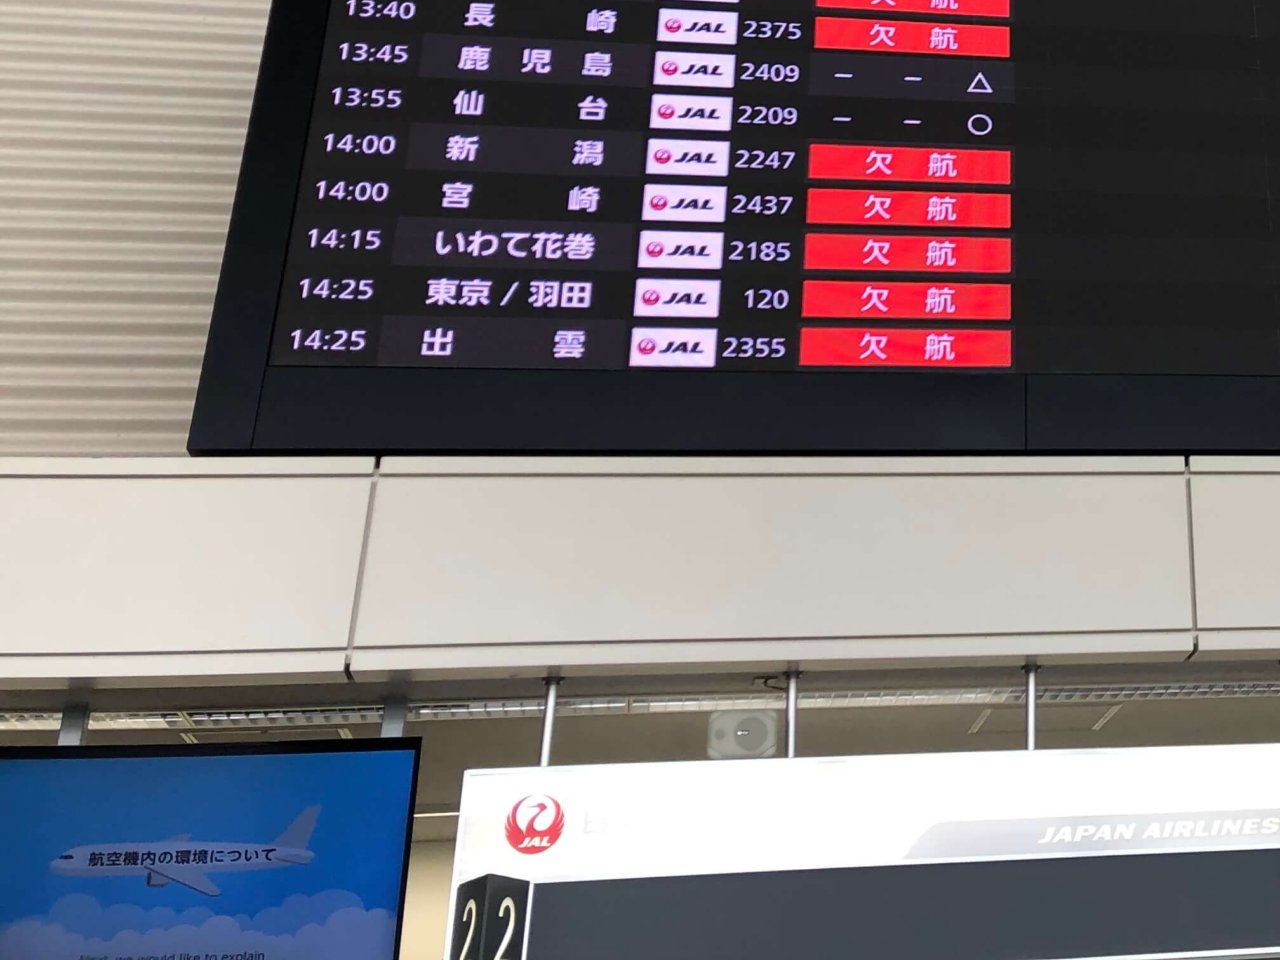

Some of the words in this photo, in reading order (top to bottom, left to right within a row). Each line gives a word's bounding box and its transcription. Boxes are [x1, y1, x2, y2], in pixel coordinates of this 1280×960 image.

[347, 0, 416, 19] 13:40
[684, 21, 727, 34] JAL
[743, 21, 801, 39] 2375
[340, 43, 408, 63] 13:45
[681, 64, 724, 76] JAL
[740, 63, 799, 82] 2409
[332, 87, 401, 108] 13:55
[677, 107, 721, 120] JAL
[737, 106, 797, 125] 2209
[324, 133, 396, 154] 14:00
[674, 151, 718, 164] JAL
[735, 150, 795, 169] 2247
[316, 181, 389, 201] 14:00
[670, 198, 714, 210] JAL
[732, 195, 793, 214] 2437
[309, 229, 381, 249] 14:15
[667, 244, 711, 257] JAL
[729, 241, 790, 261] 2185
[300, 279, 373, 299] 14:25
[662, 292, 708, 305] JAL
[745, 289, 789, 309] 120
[291, 329, 366, 350] 14:25
[659, 341, 704, 354] JAL
[722, 337, 785, 357] 2355
[518, 836, 551, 848] JAL
[1038, 823, 1136, 844] JAPAN
[1142, 817, 1280, 839] AIRLINES
[88, 848, 277, 867] 航空機内の環境について
[493, 897, 515, 960] 2
